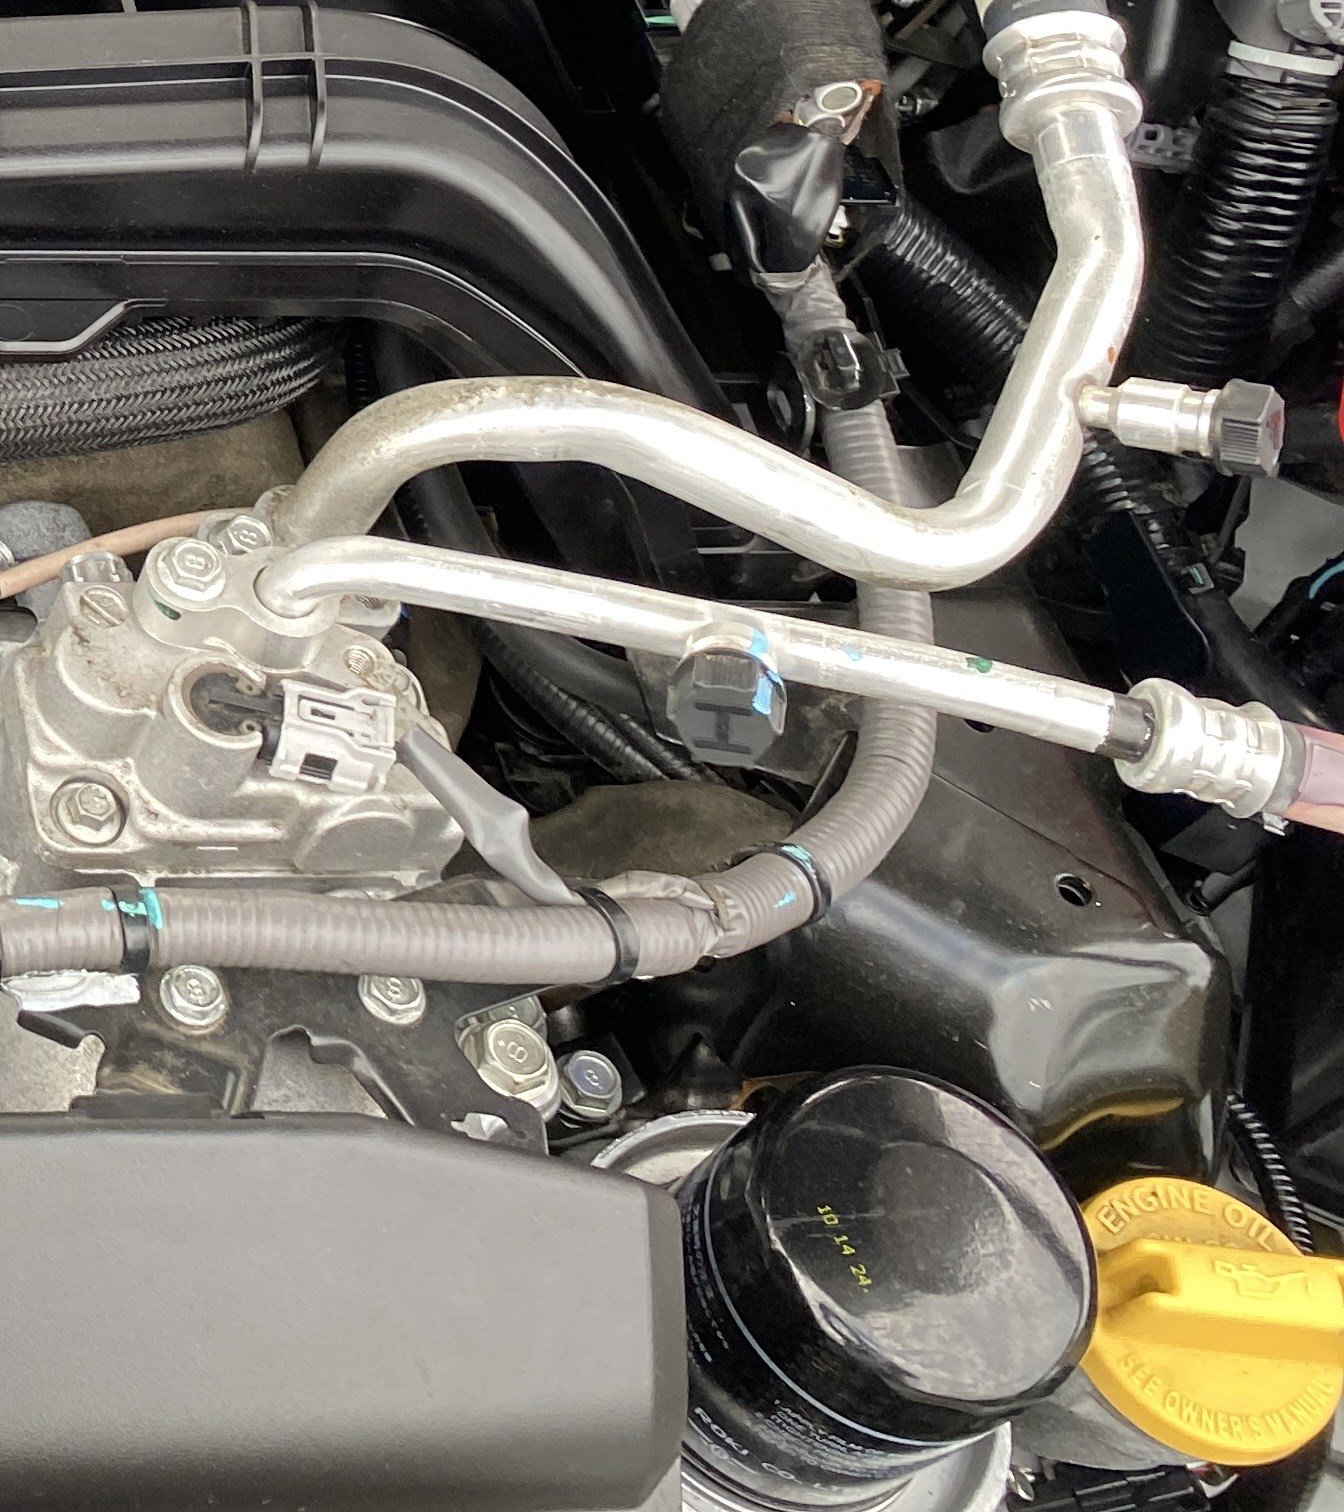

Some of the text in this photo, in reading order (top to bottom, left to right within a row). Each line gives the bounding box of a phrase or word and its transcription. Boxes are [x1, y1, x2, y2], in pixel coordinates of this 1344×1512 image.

[816, 1204, 873, 1287] 10 14 24
[1097, 1183, 1275, 1253] ENGINE OIL
[694, 1406, 751, 1457] ROKI
[1117, 1352, 1336, 1440] SEE OWNER'S MANUAL
